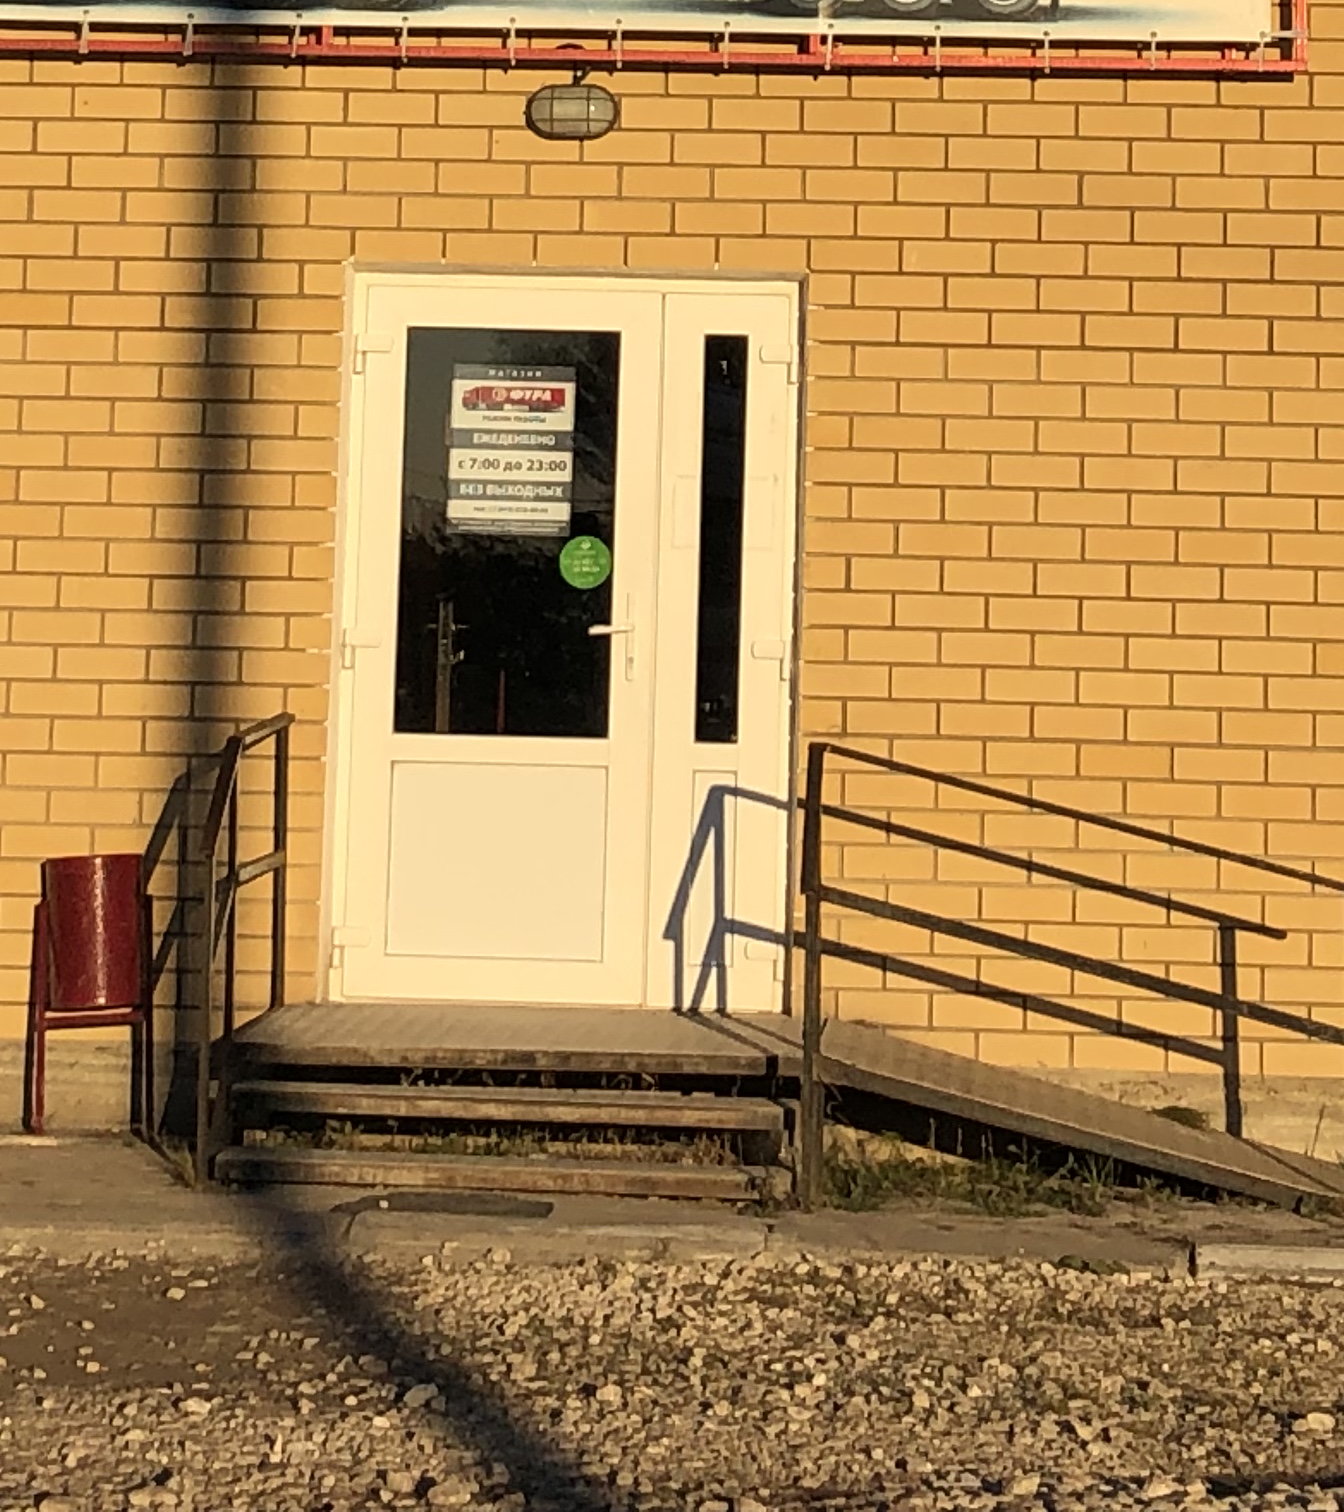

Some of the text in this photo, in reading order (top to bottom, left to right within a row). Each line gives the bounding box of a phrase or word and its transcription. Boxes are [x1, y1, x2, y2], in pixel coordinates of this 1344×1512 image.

[509, 389, 552, 402] ФУРА
[468, 457, 501, 471] 7:00
[502, 460, 523, 473] до
[526, 458, 568, 472] 23:00
[485, 484, 564, 499] ВЫХОДНЫХ
